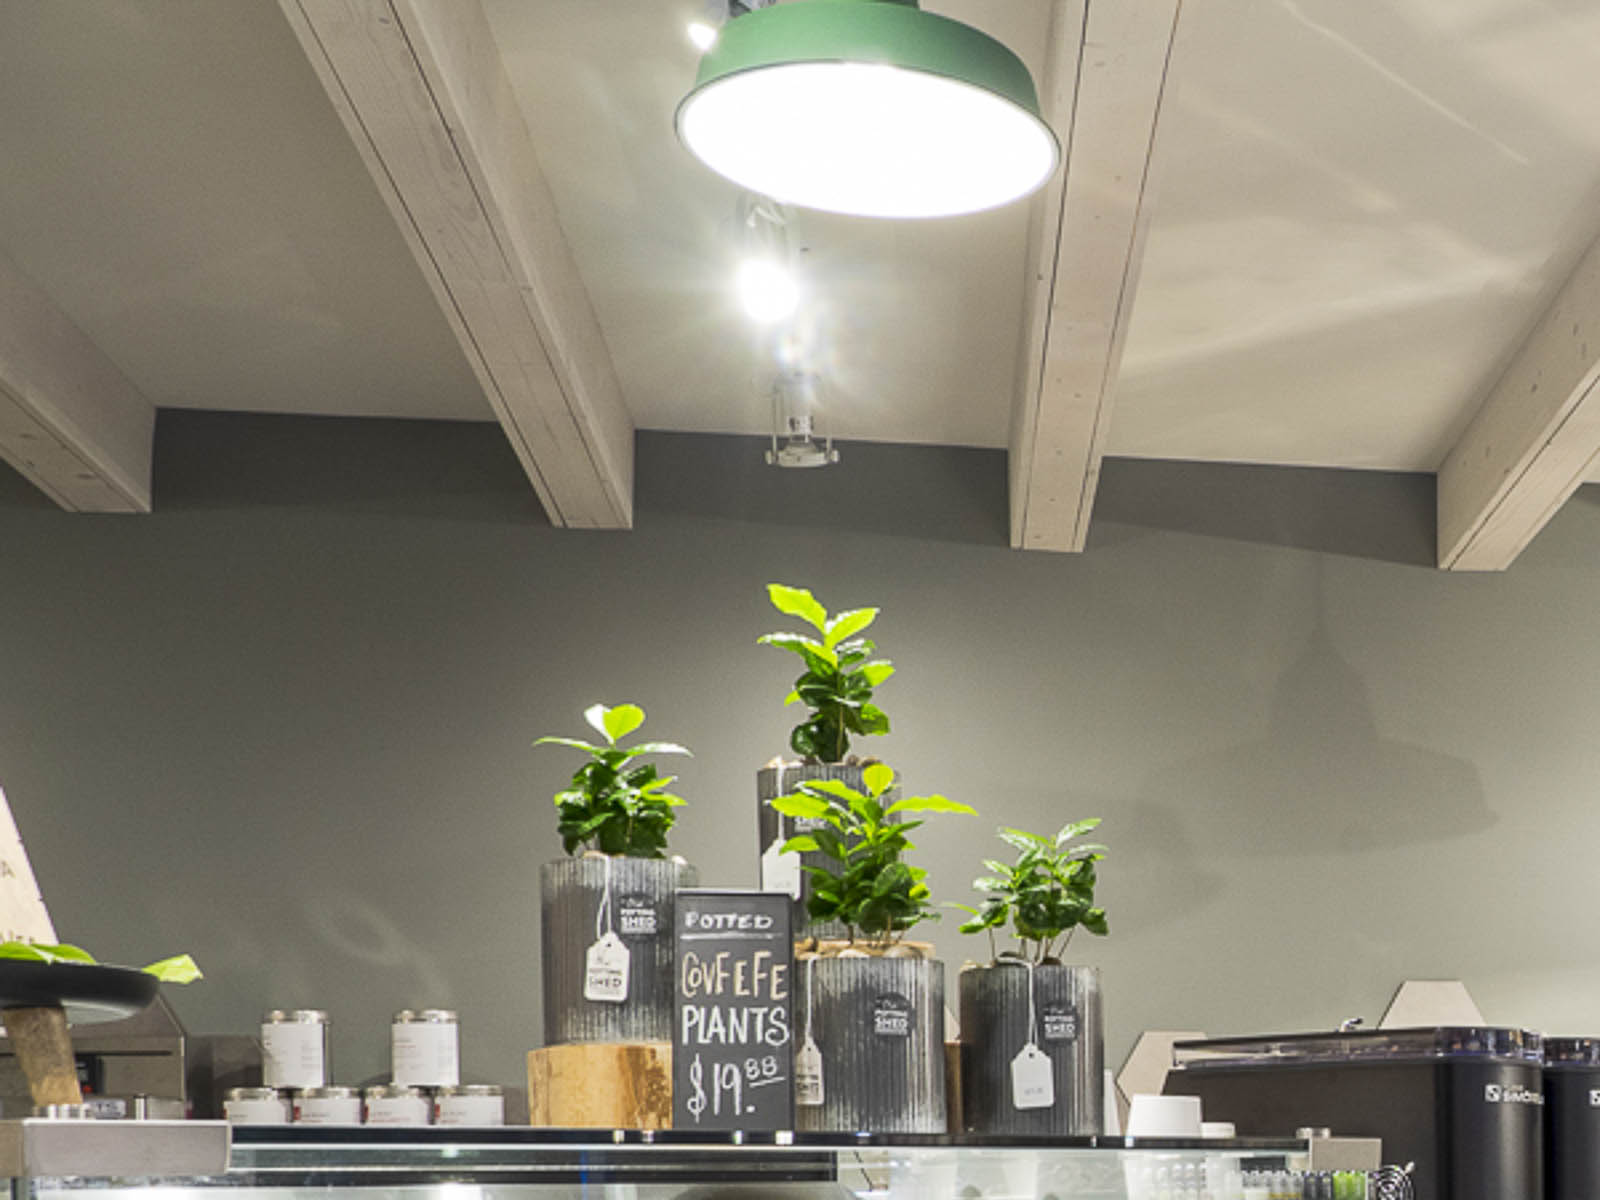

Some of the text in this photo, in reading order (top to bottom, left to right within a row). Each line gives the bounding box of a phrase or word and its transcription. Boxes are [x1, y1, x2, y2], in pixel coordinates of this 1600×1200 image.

[684, 911, 774, 930] POTTED
[681, 950, 788, 1000] COVFEFE
[681, 1004, 790, 1046] PLANTS
